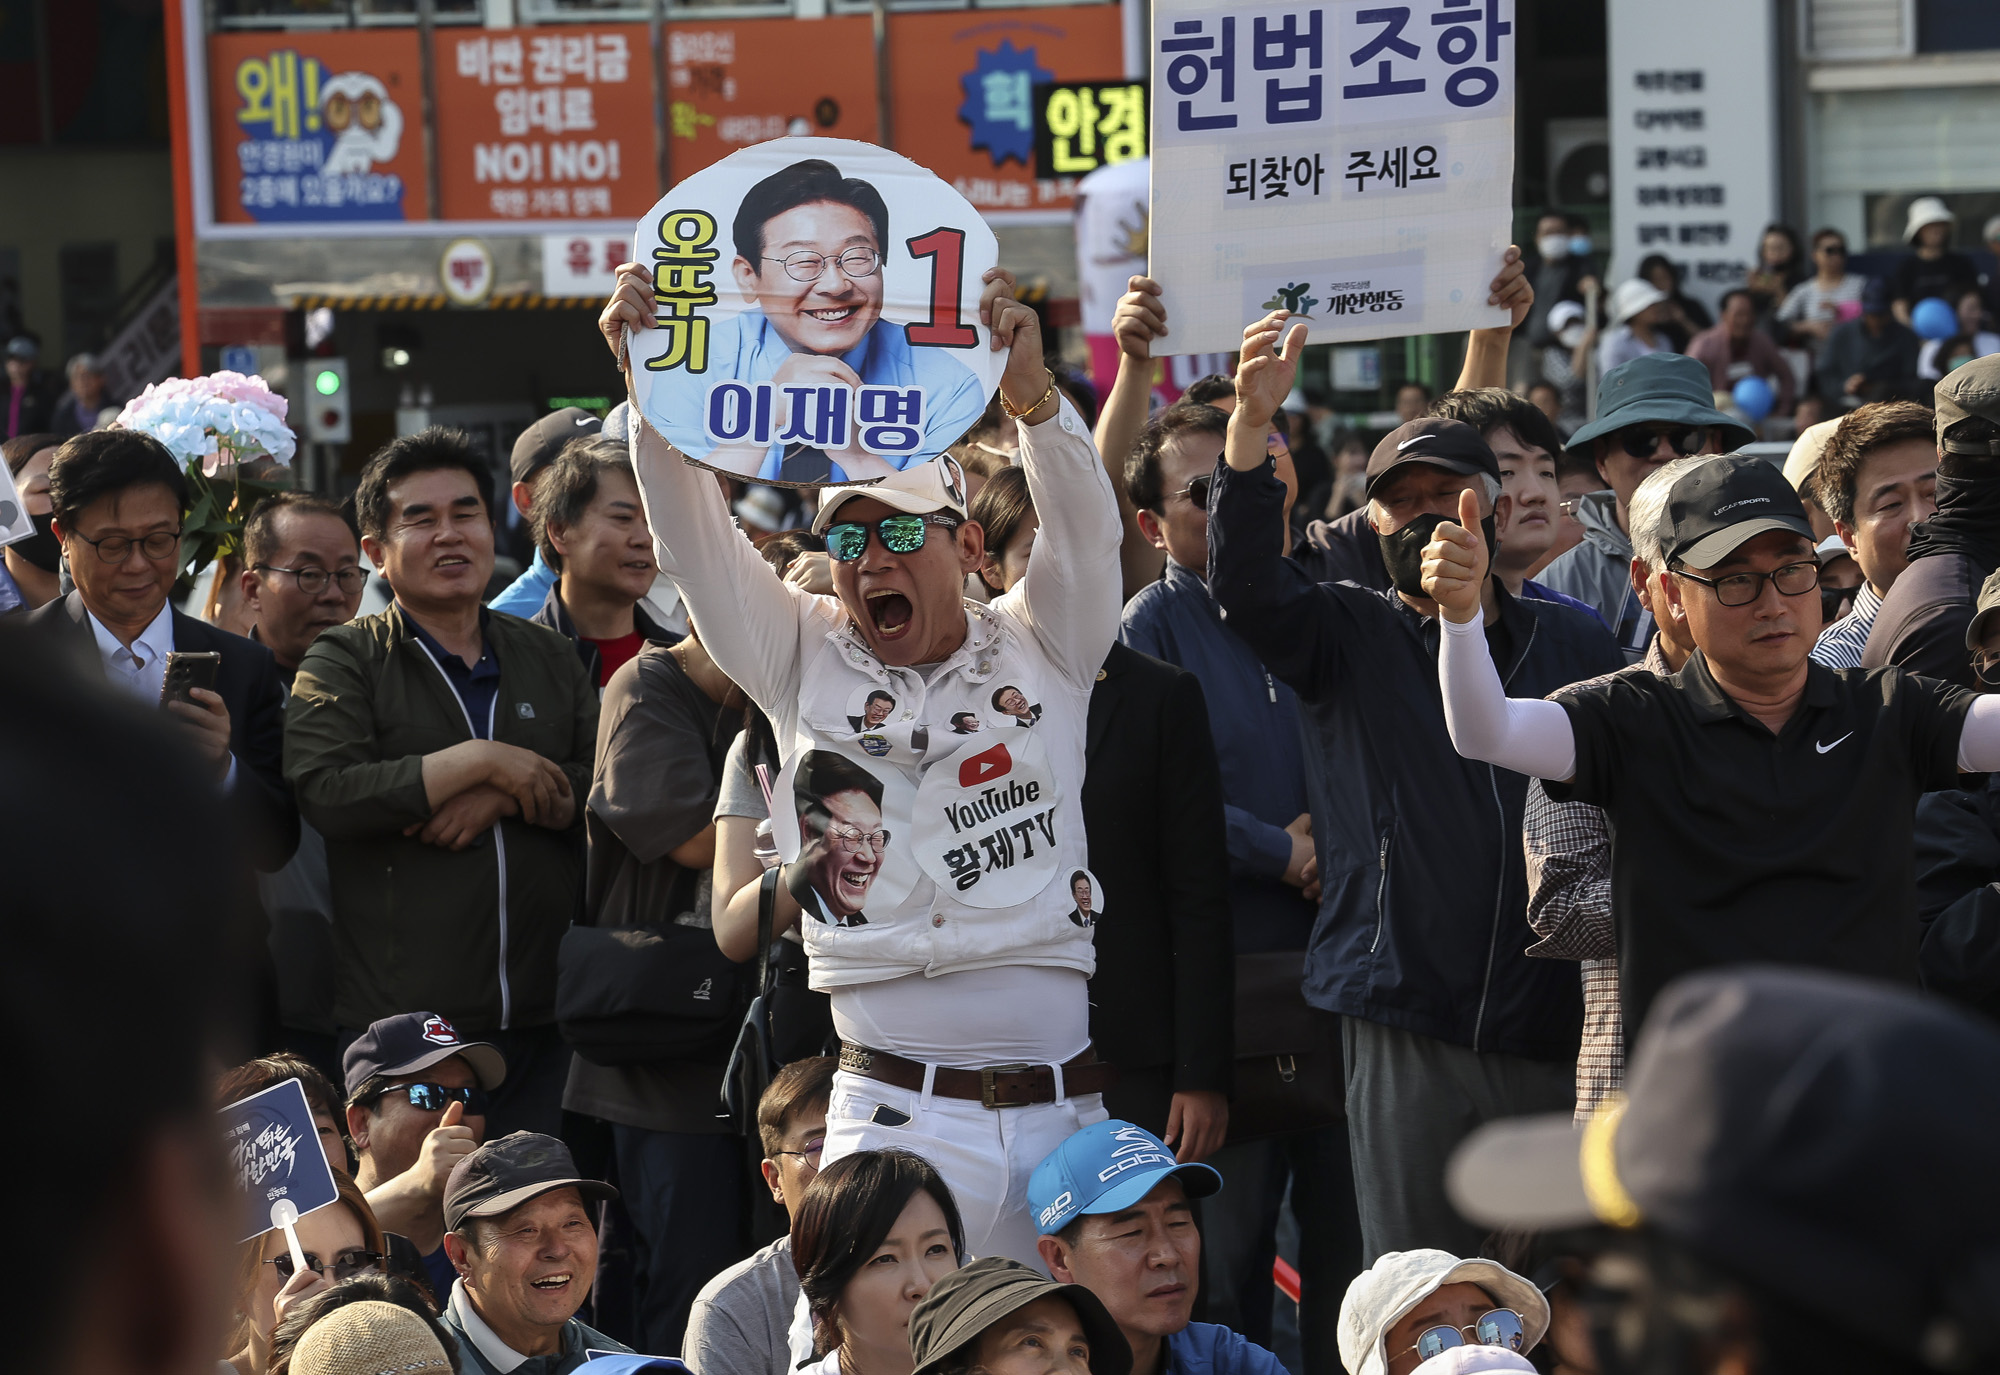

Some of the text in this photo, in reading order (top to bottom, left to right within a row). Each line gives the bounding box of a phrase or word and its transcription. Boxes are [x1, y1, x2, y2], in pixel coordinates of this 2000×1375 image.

[457, 33, 630, 86] 비싼 권리금
[237, 50, 321, 140] 왜!
[494, 86, 597, 136] 임대료
[1046, 85, 1146, 173] 안경
[474, 140, 620, 182] NO! NO!
[1226, 145, 1441, 200] 되찾아 주세요
[645, 209, 720, 374] 오뚜기
[904, 227, 979, 348] 1
[1326, 290, 1405, 315] 개헌행동
[707, 382, 922, 453] 이재명
[944, 780, 1041, 834] YouTube
[942, 807, 1058, 891] 황제TV
[1098, 1153, 1177, 1183] cobra
